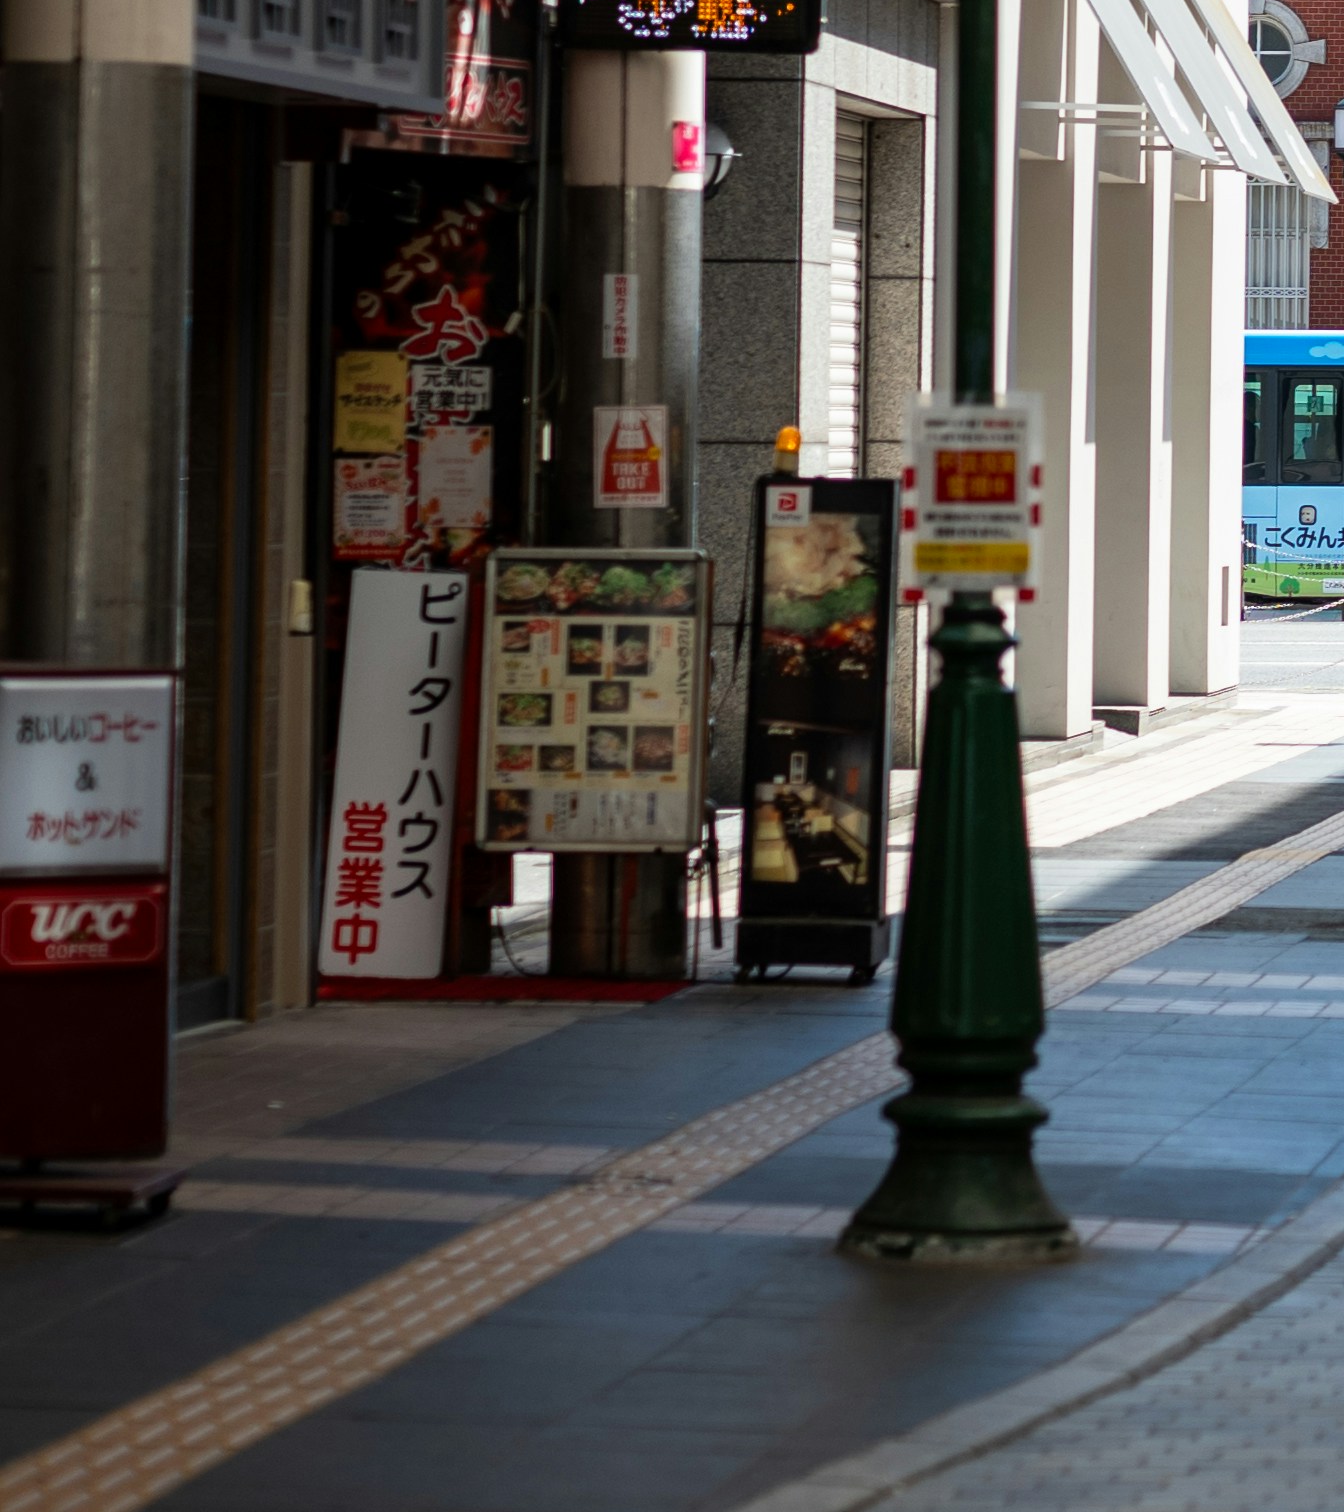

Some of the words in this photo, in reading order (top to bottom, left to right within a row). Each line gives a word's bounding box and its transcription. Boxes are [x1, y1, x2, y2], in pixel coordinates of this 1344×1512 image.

[422, 367, 485, 388] 元気に
[612, 462, 650, 476] TAKE
[616, 477, 647, 490] OUT
[16, 712, 157, 744] おいしいコーヒー
[391, 582, 462, 900] ピーターハウス
[75, 761, 96, 792] &
[26, 809, 142, 841] ホットサンド
[331, 801, 388, 965] 営業中
[30, 902, 137, 943] UCC
[45, 943, 109, 960] COFFEE
